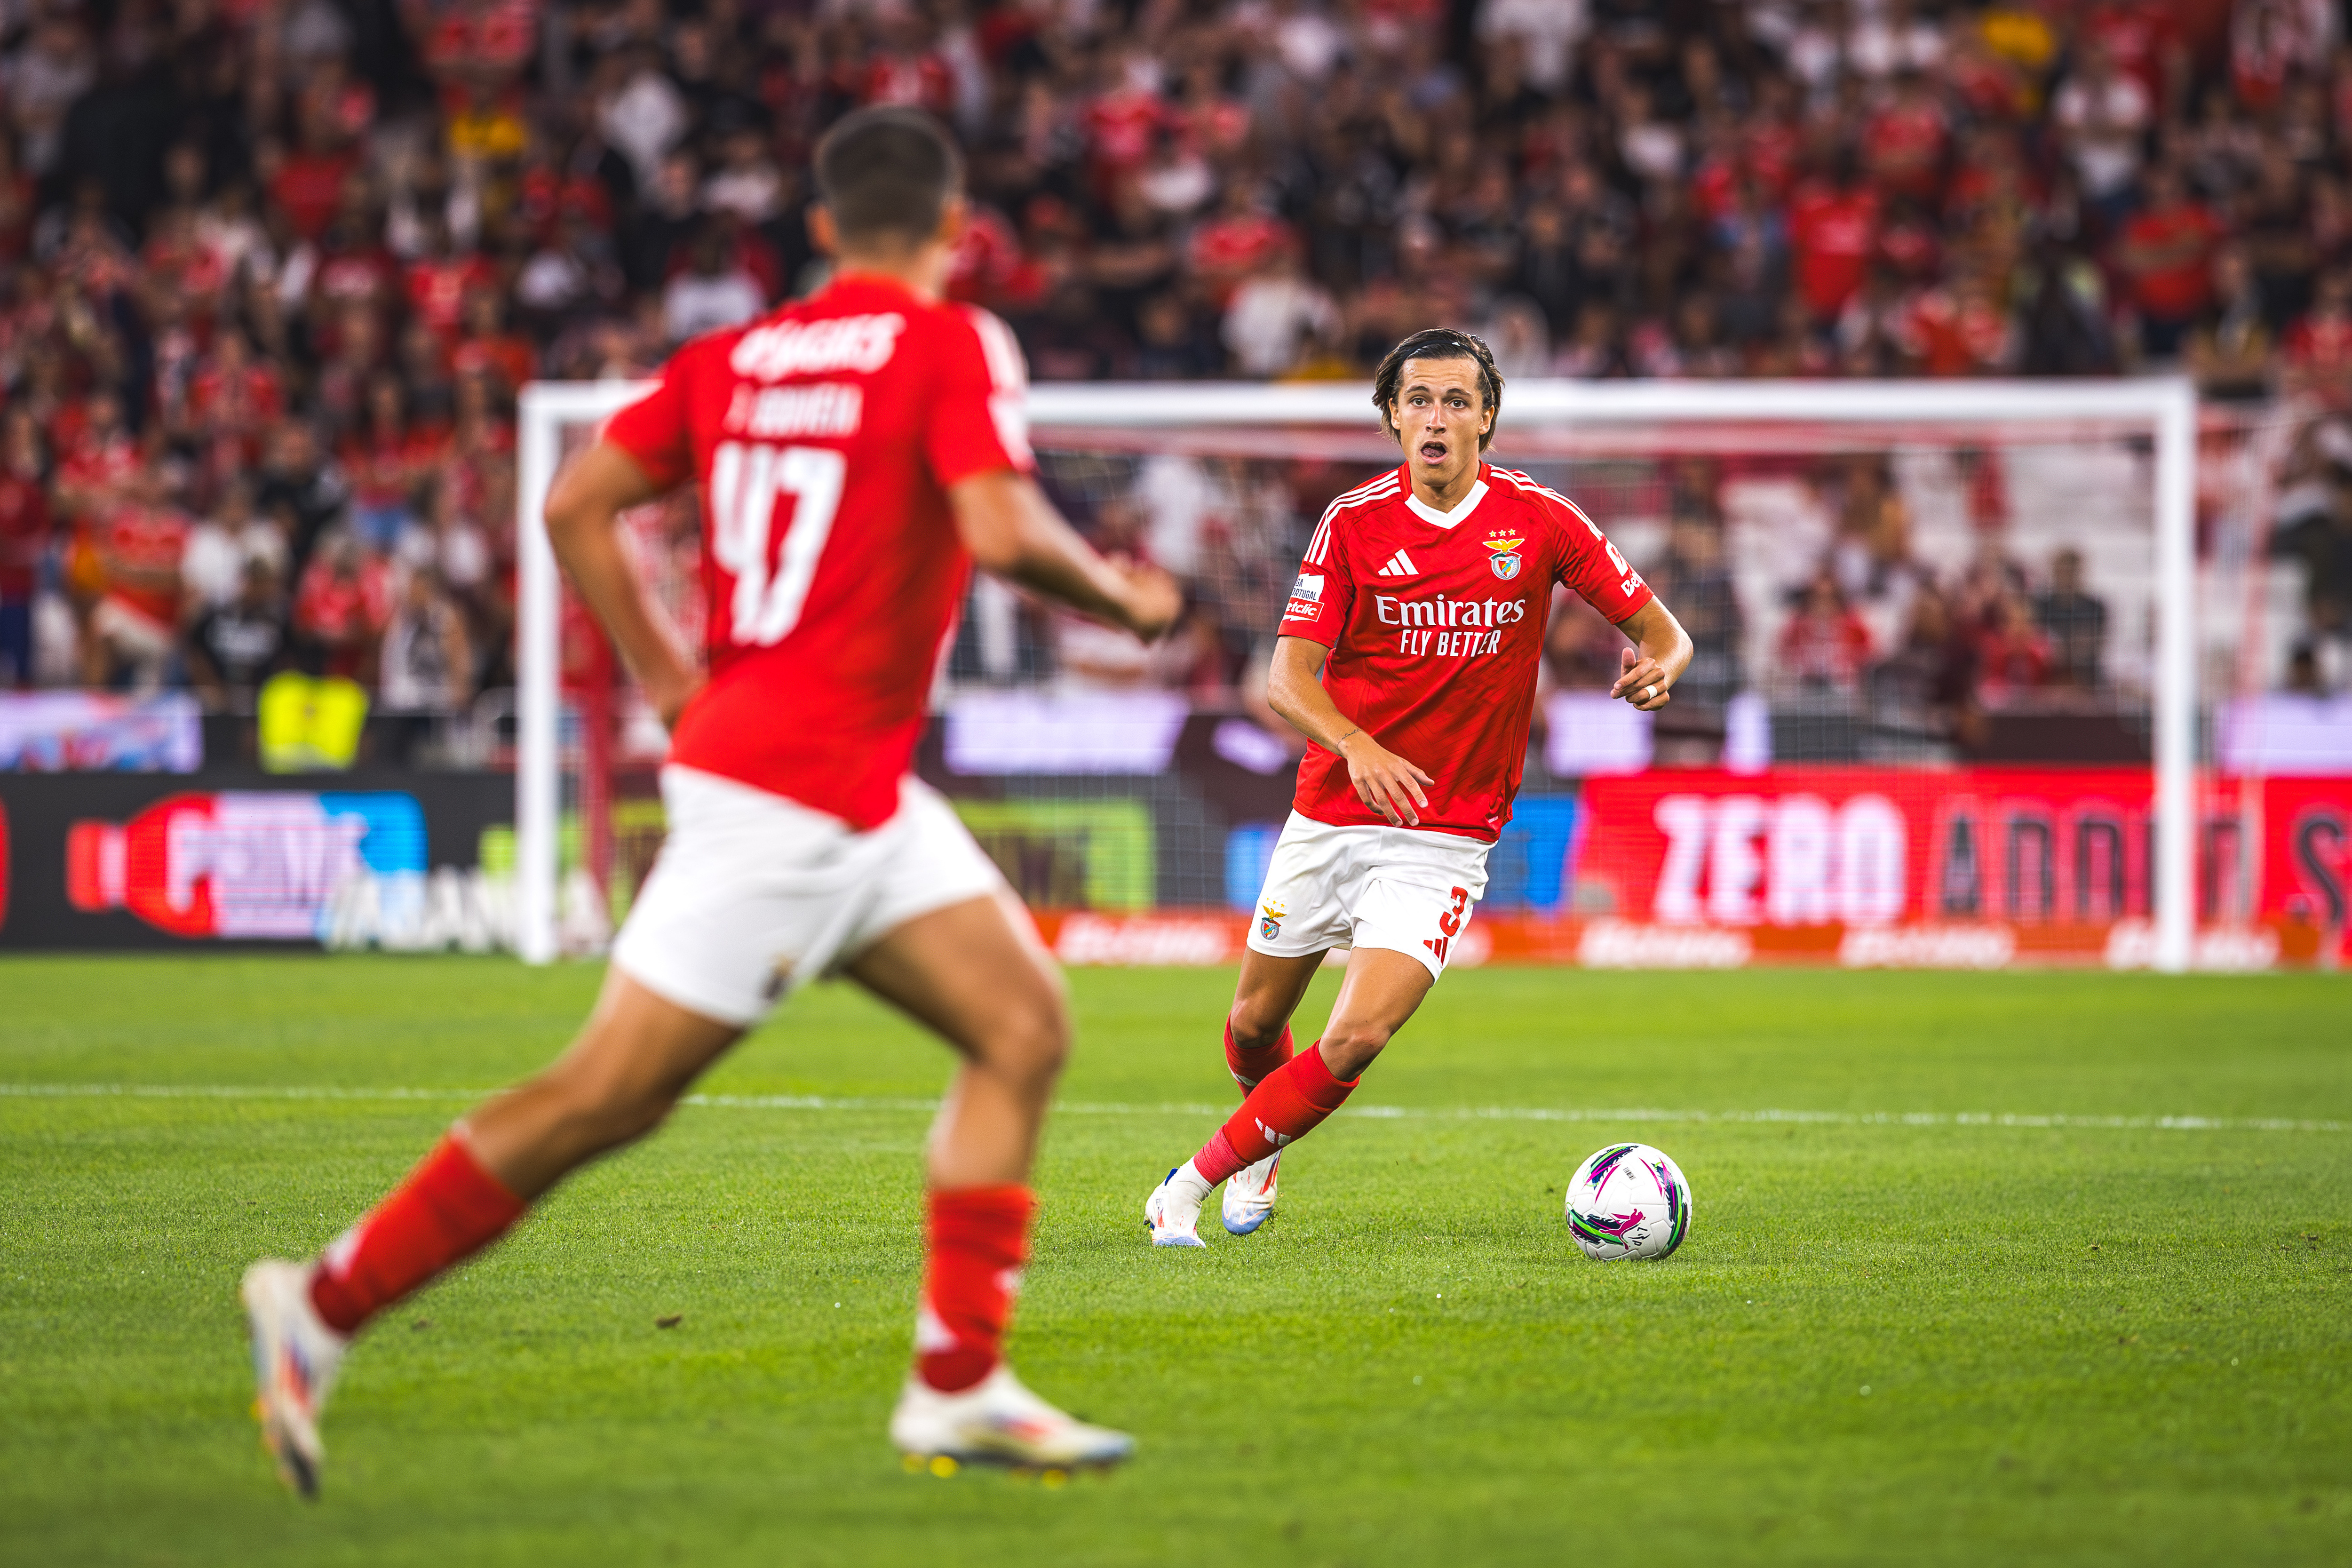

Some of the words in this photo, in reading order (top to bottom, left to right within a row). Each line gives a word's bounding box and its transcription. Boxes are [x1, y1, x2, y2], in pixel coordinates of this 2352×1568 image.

[710, 438, 847, 648] 47
[1291, 588, 1316, 600] ORTUGAL
[1295, 578, 1303, 587] GA
[1620, 572, 1643, 598] Bet
[1286, 601, 1317, 616] etclic
[1374, 593, 1526, 627] Emirates
[1400, 629, 1432, 656] FLY
[1436, 629, 1502, 657] BETTER
[1653, 792, 1907, 929] ZERO
[1439, 886, 1468, 937] 3
